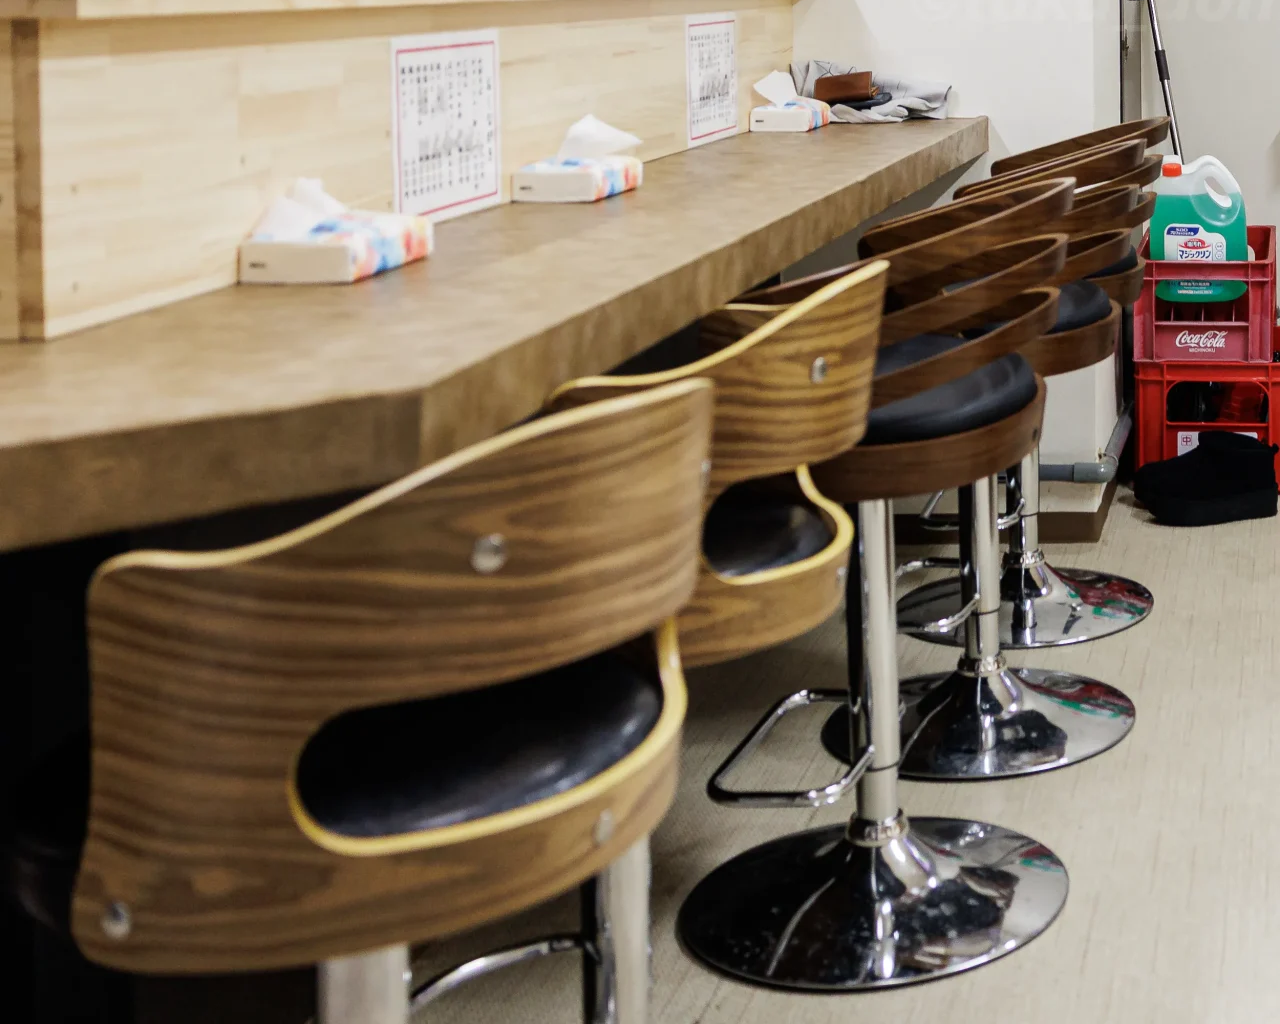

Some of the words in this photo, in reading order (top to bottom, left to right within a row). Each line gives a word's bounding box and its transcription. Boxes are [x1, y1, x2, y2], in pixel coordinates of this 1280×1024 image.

[1178, 249, 1212, 260] マジックリン
[1175, 330, 1228, 348] Coca-Cola
